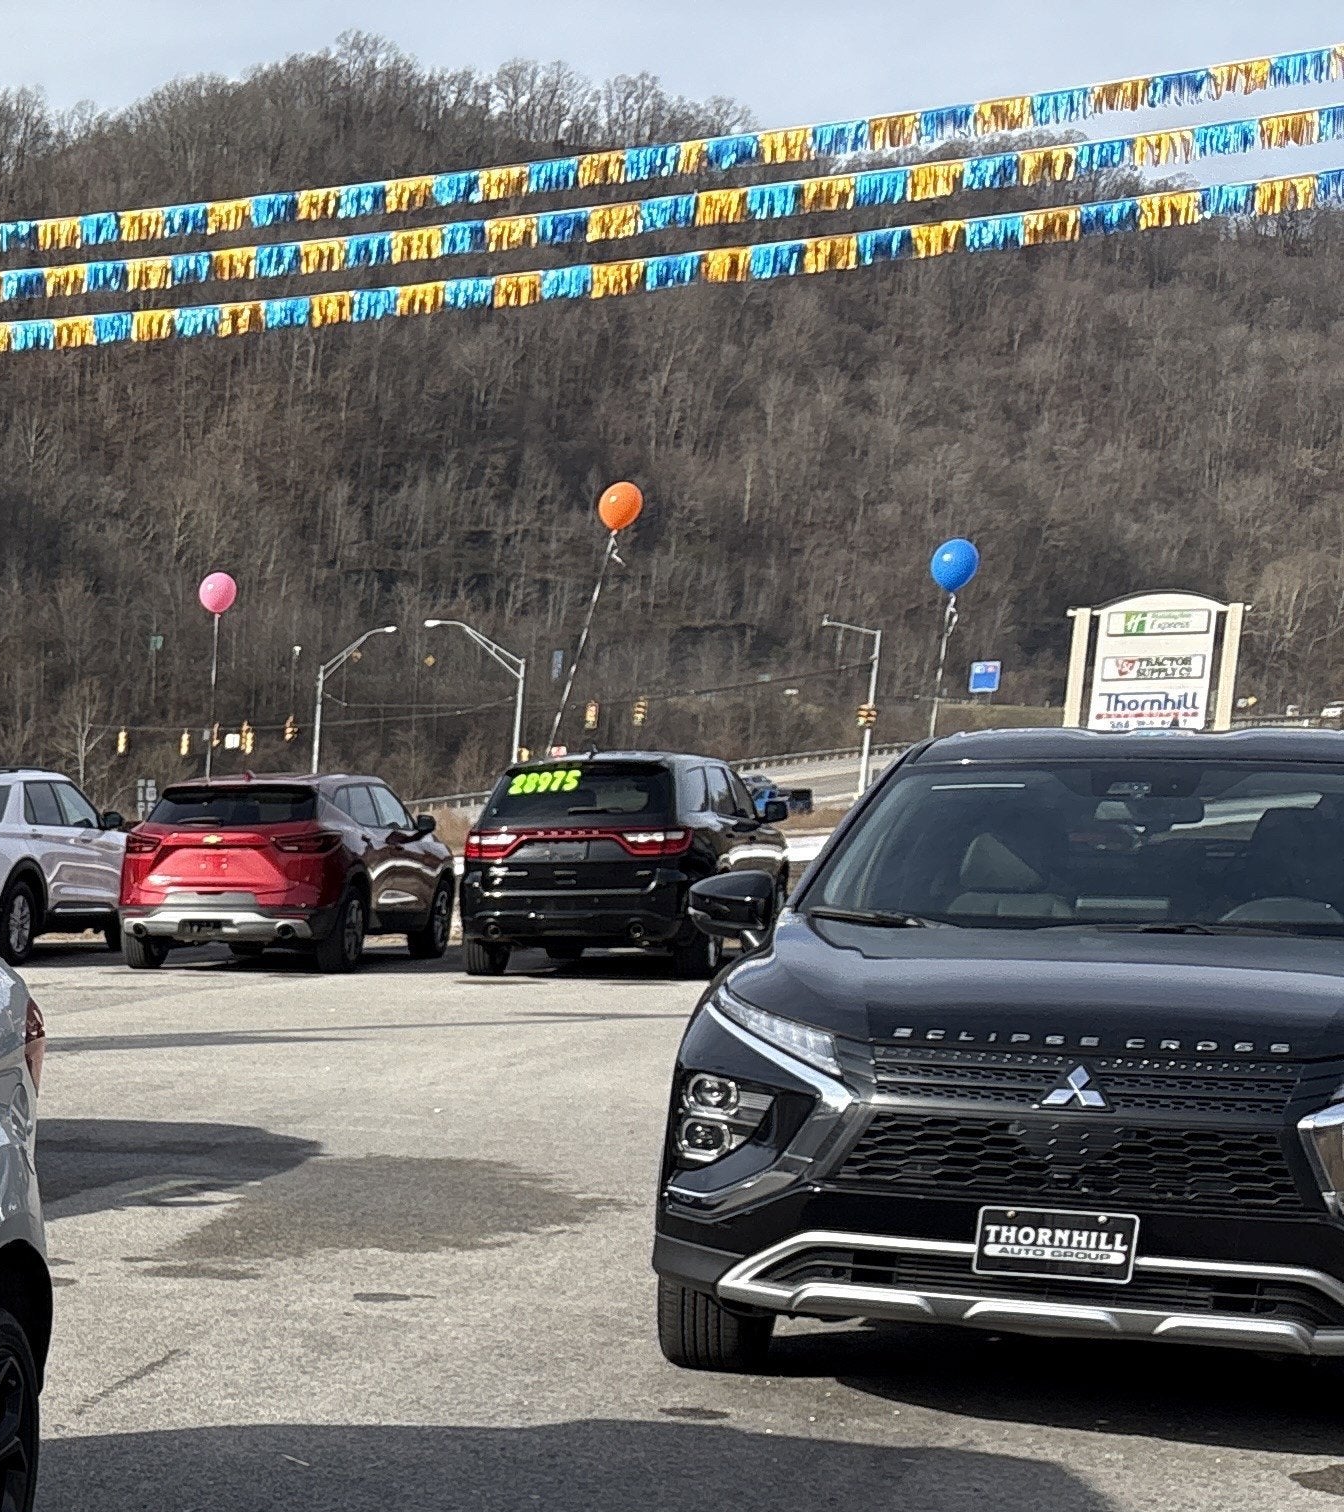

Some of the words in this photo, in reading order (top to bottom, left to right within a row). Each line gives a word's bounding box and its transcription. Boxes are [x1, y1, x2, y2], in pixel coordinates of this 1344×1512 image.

[1099, 691, 1200, 712] Thornhill
[506, 769, 582, 796] 28975
[892, 1026, 1100, 1047] ECLIPSE
[1125, 1038, 1291, 1054] CROSS
[984, 1224, 1129, 1252] THORNHILL
[998, 1246, 1045, 1258] AUTO
[1050, 1249, 1112, 1261] GROUP
